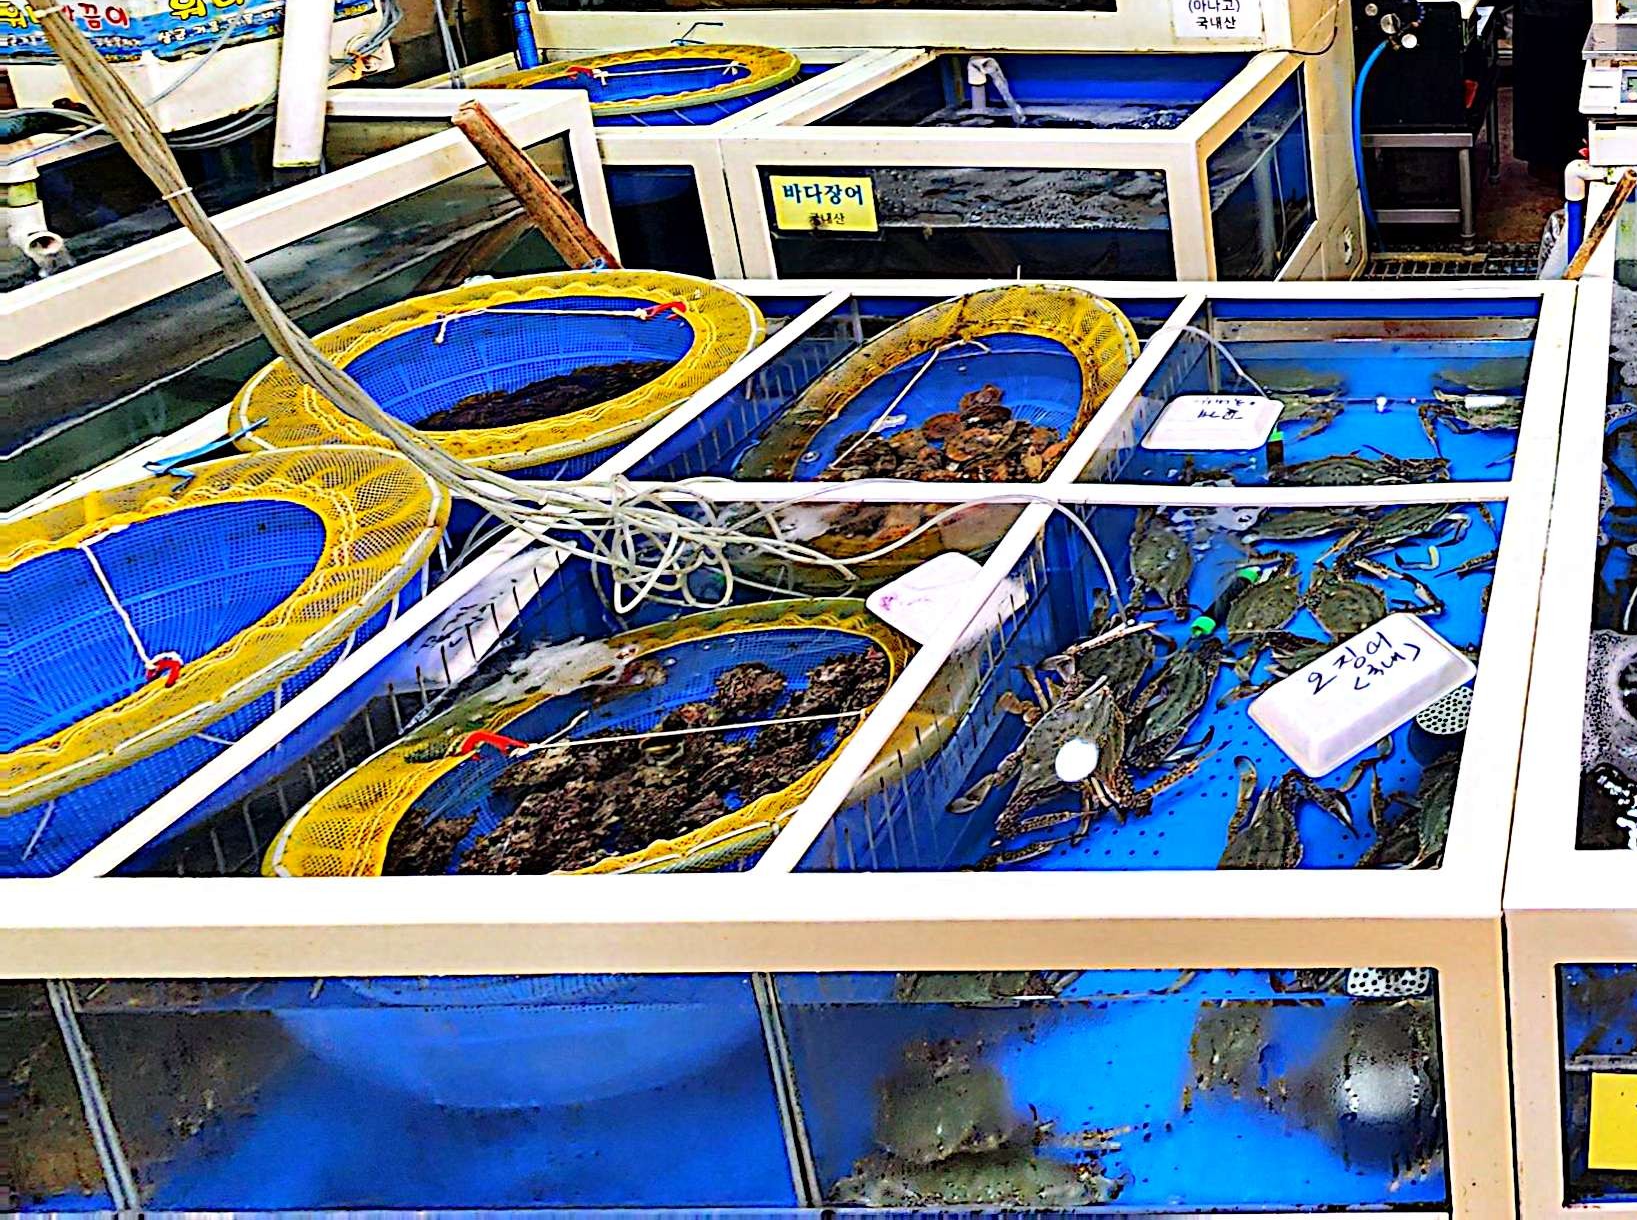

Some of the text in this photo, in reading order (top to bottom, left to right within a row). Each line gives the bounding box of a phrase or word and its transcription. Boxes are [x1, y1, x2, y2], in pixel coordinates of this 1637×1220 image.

[1195, 16, 1237, 30] 국내산
[783, 183, 864, 206] 바다장어
[809, 212, 846, 225] 국내산
[1307, 630, 1393, 696] 오징어
